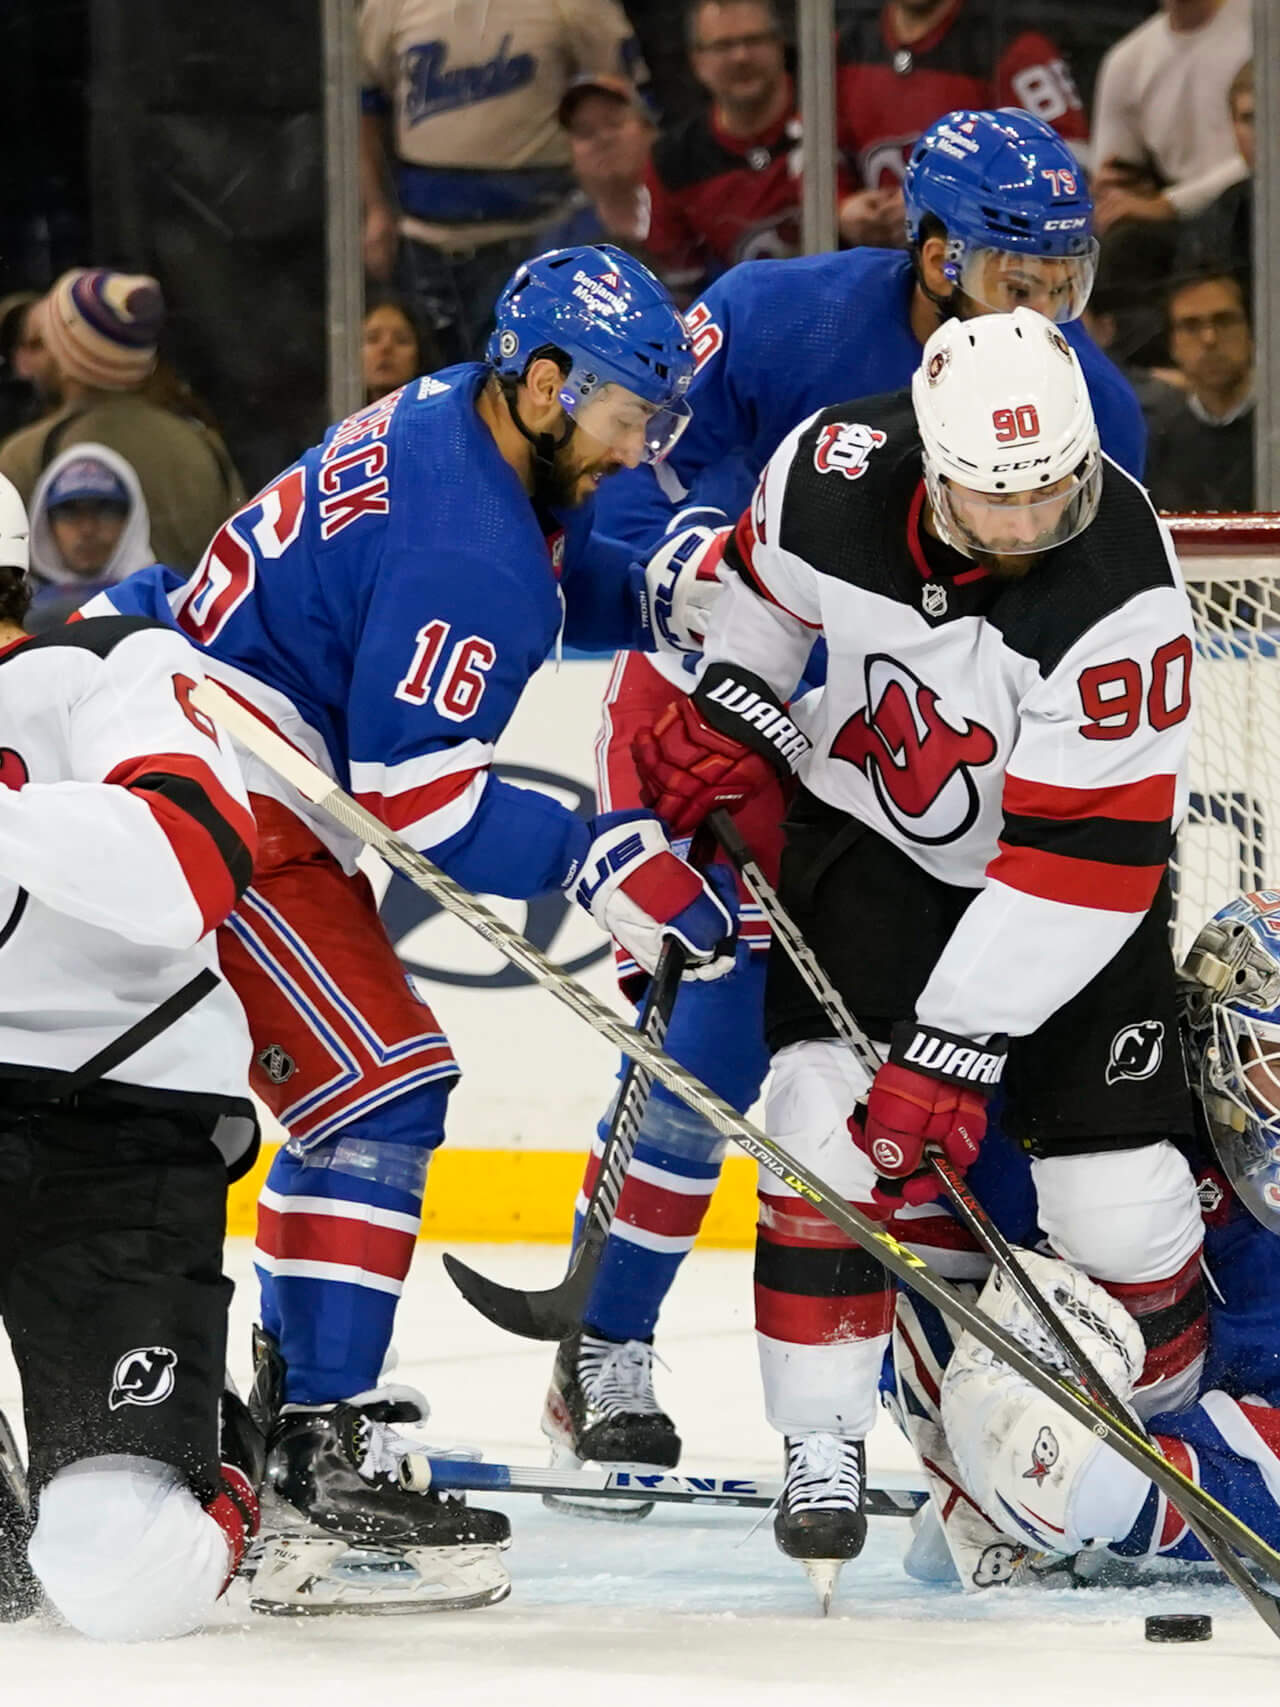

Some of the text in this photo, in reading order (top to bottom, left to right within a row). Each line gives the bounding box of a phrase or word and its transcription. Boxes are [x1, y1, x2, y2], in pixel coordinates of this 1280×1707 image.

[1041, 168, 1077, 197] 79
[1043, 217, 1087, 231] CCM
[571, 284, 615, 317] Moore
[573, 270, 629, 314] Benjamin
[993, 404, 1041, 443] 90
[991, 455, 1051, 473] CCM
[394, 619, 496, 723] 16
[1077, 633, 1193, 741] 90
[738, 1138, 785, 1177] ALPHA
[784, 1175, 809, 1193] LX
